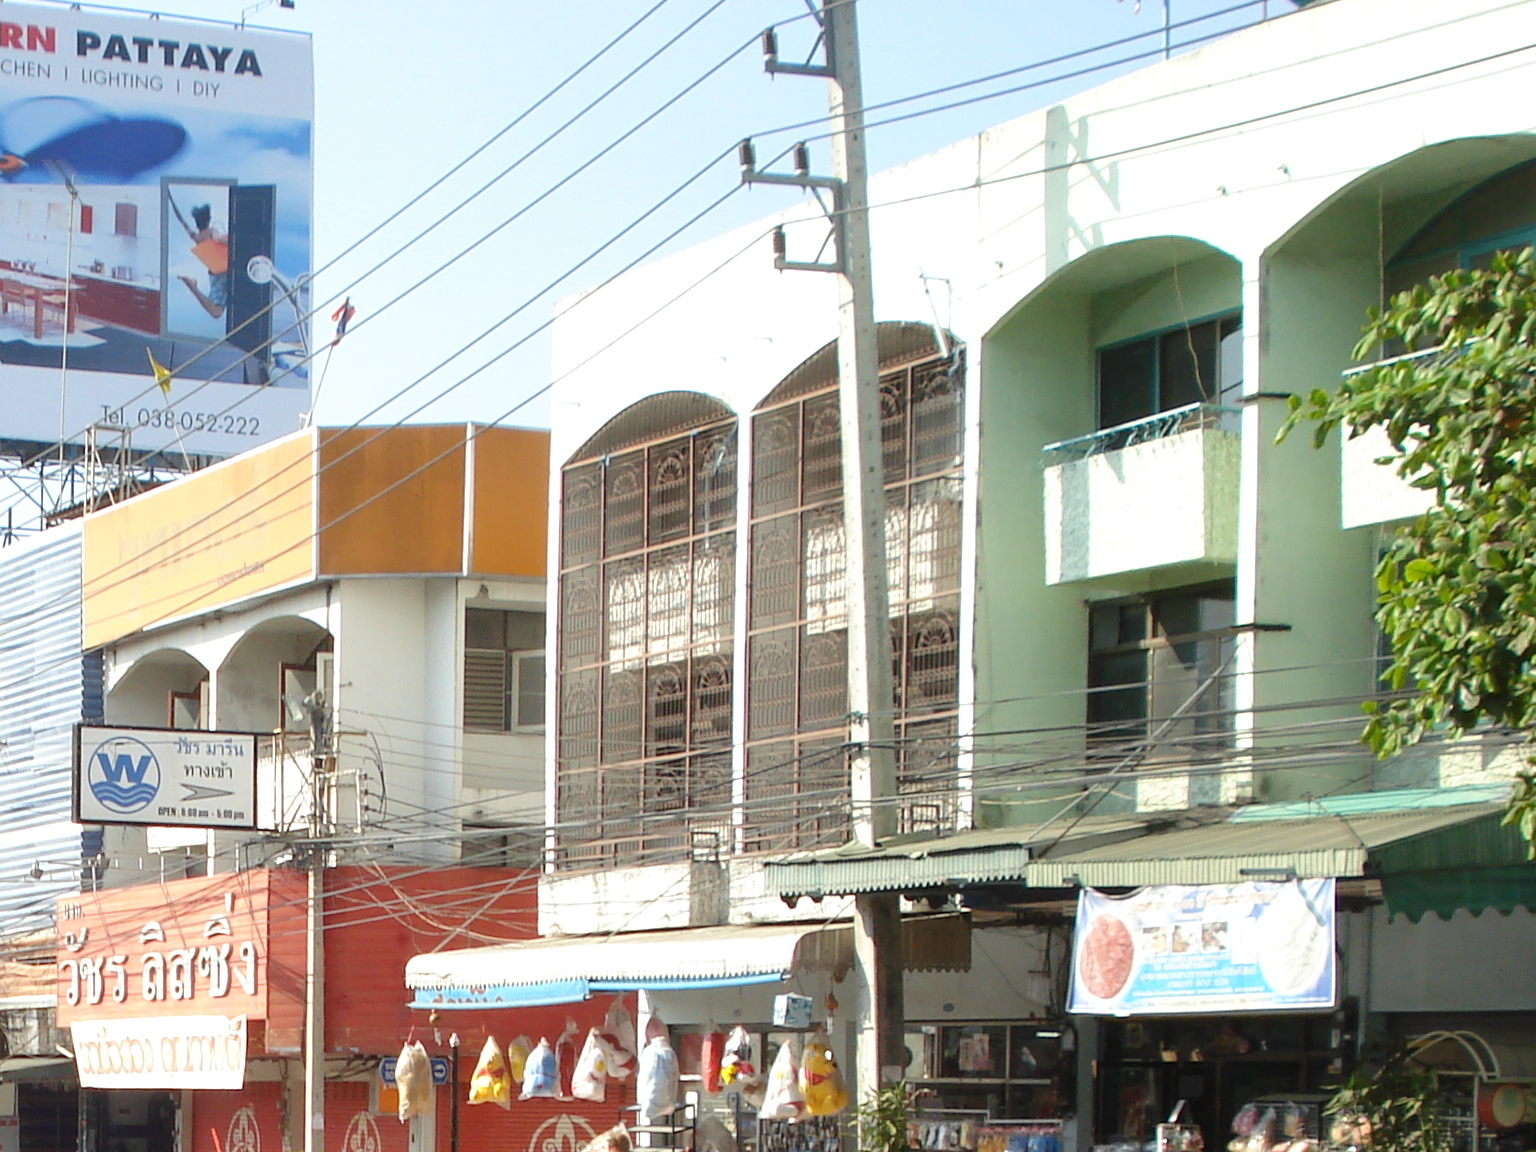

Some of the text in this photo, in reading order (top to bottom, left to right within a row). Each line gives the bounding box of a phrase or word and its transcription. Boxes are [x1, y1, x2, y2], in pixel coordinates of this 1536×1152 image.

[76, 30, 262, 77] PATTAYA
[81, 69, 164, 92] LIGHTING
[193, 80, 220, 98] DIY
[100, 405, 261, 437] Tel. 038-052-222
[96, 753, 154, 783] W
[183, 762, 233, 780] ทางเข้า
[158, 806, 177, 817] OPEN
